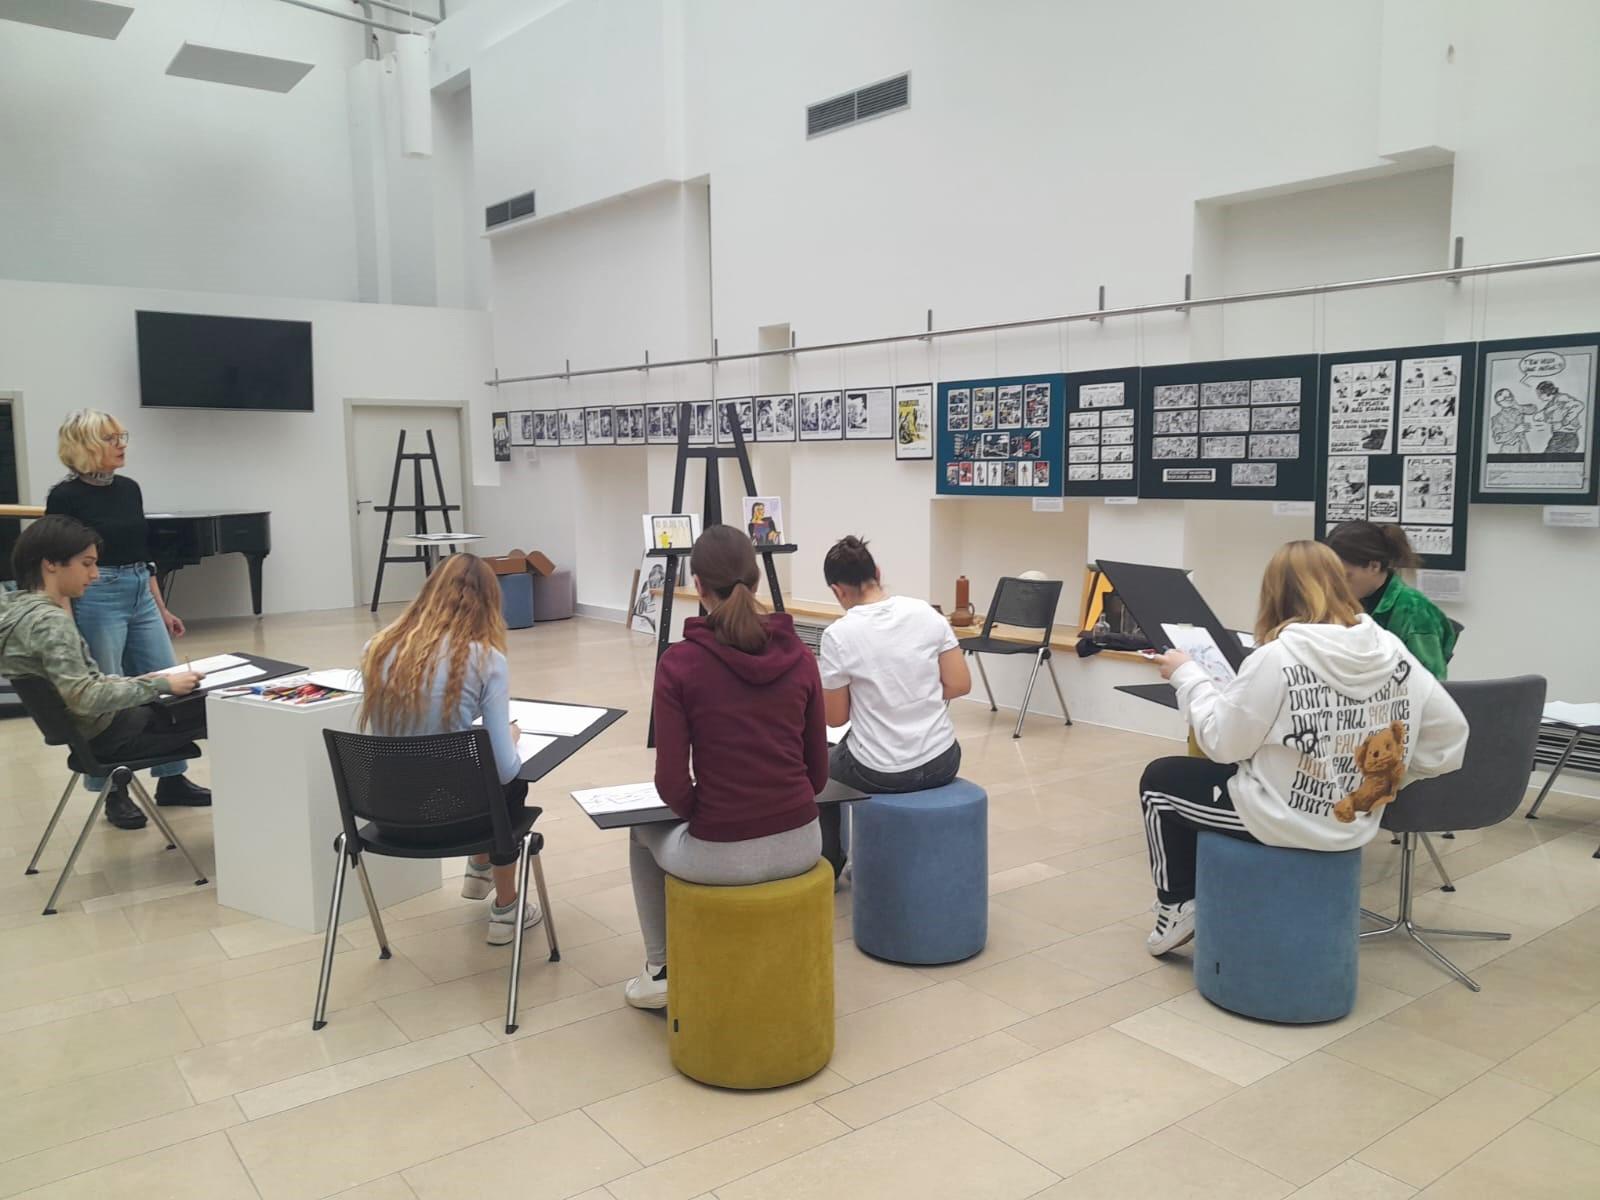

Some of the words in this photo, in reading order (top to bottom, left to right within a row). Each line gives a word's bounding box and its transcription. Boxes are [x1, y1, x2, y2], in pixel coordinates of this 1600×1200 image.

[1283, 664, 1318, 687] DON
[1289, 685, 1331, 711] DON'T
[1291, 709, 1333, 735] DON'T
[1336, 708, 1366, 730] FALL
[1369, 702, 1389, 726] FOR
[1292, 770, 1337, 800] DON'T
[1287, 791, 1335, 817] DON'T
